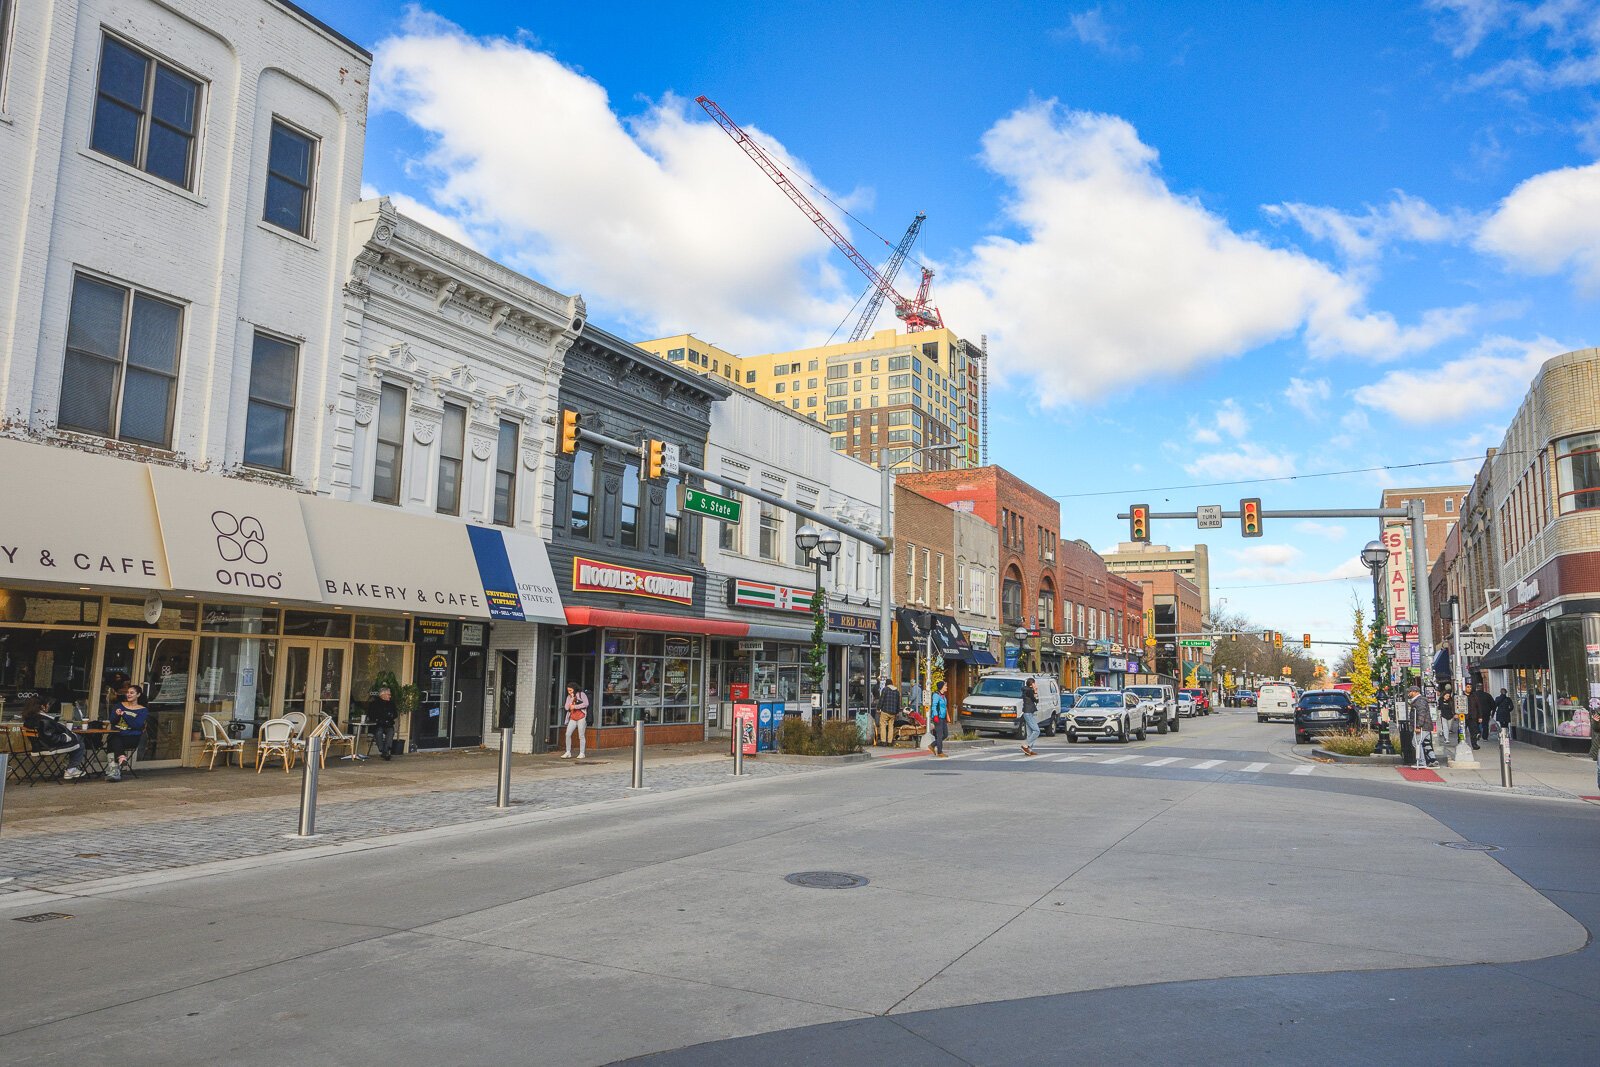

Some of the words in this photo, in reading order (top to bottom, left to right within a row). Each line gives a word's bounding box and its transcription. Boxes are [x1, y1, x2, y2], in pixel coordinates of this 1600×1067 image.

[700, 498, 708, 509] S.
[710, 501, 730, 515] State
[40, 550, 56, 567] &
[74, 553, 156, 576] CAFE
[580, 564, 636, 590] NOODLES
[644, 576, 694, 598] COMPANY
[1390, 533, 1405, 620] STATE
[326, 580, 407, 600] BAKERY
[417, 589, 426, 602] &
[435, 591, 480, 607] CAFE
[486, 590, 518, 599] UNIVERSITY
[518, 583, 541, 594] LOFTS
[522, 594, 543, 602] STATE
[841, 616, 855, 626] RED
[858, 618, 877, 629] HAWK
[1464, 638, 1490, 655] pitaya
